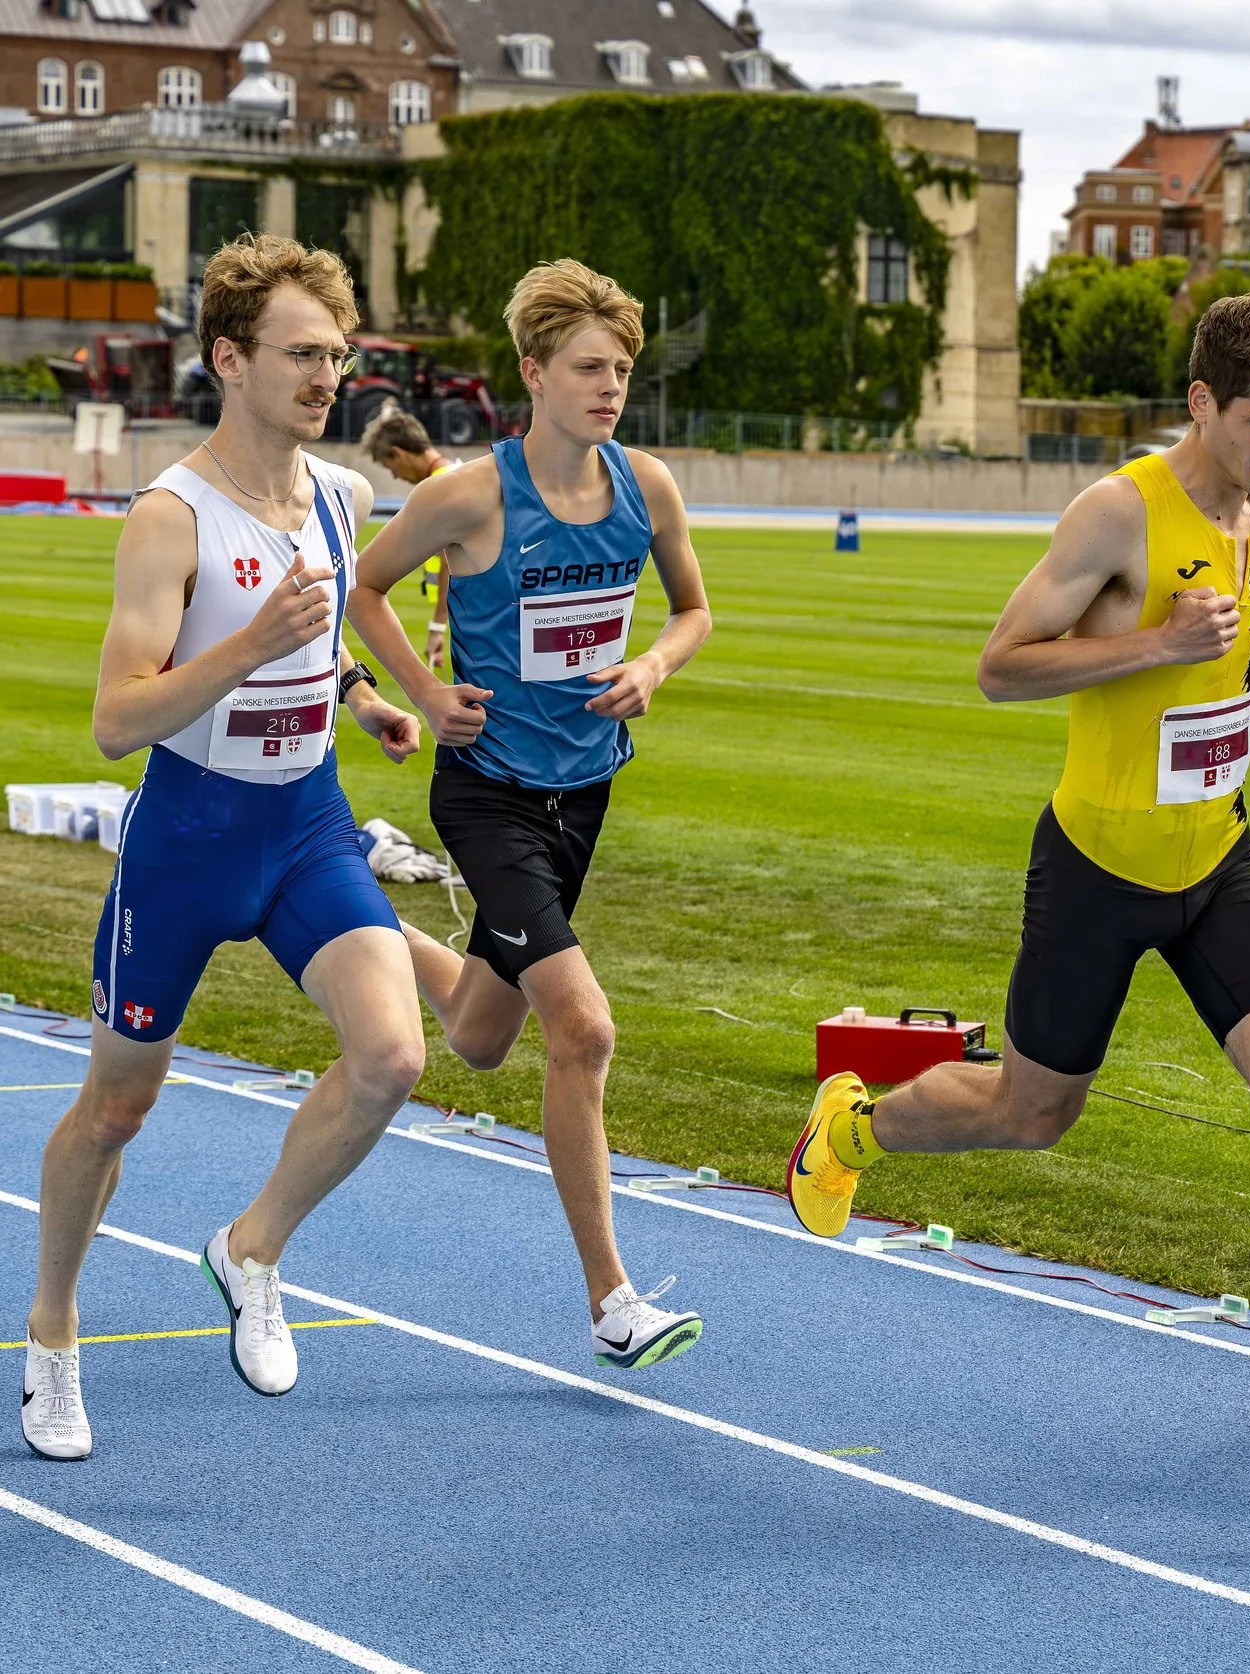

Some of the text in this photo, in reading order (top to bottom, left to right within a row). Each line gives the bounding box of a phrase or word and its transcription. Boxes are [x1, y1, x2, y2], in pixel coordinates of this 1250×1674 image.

[520, 557, 640, 590] SPARTA
[534, 616, 561, 625] DANSKE
[562, 610, 609, 623] MESTERSKABER
[567, 630, 596, 646] 179
[232, 698, 263, 707] DANSKE
[264, 693, 315, 706] MESTERSKABER
[266, 715, 300, 733] 216
[1174, 729, 1202, 739] DANSKE
[1207, 743, 1230, 763] 188
[123, 908, 132, 947] CRAFT
